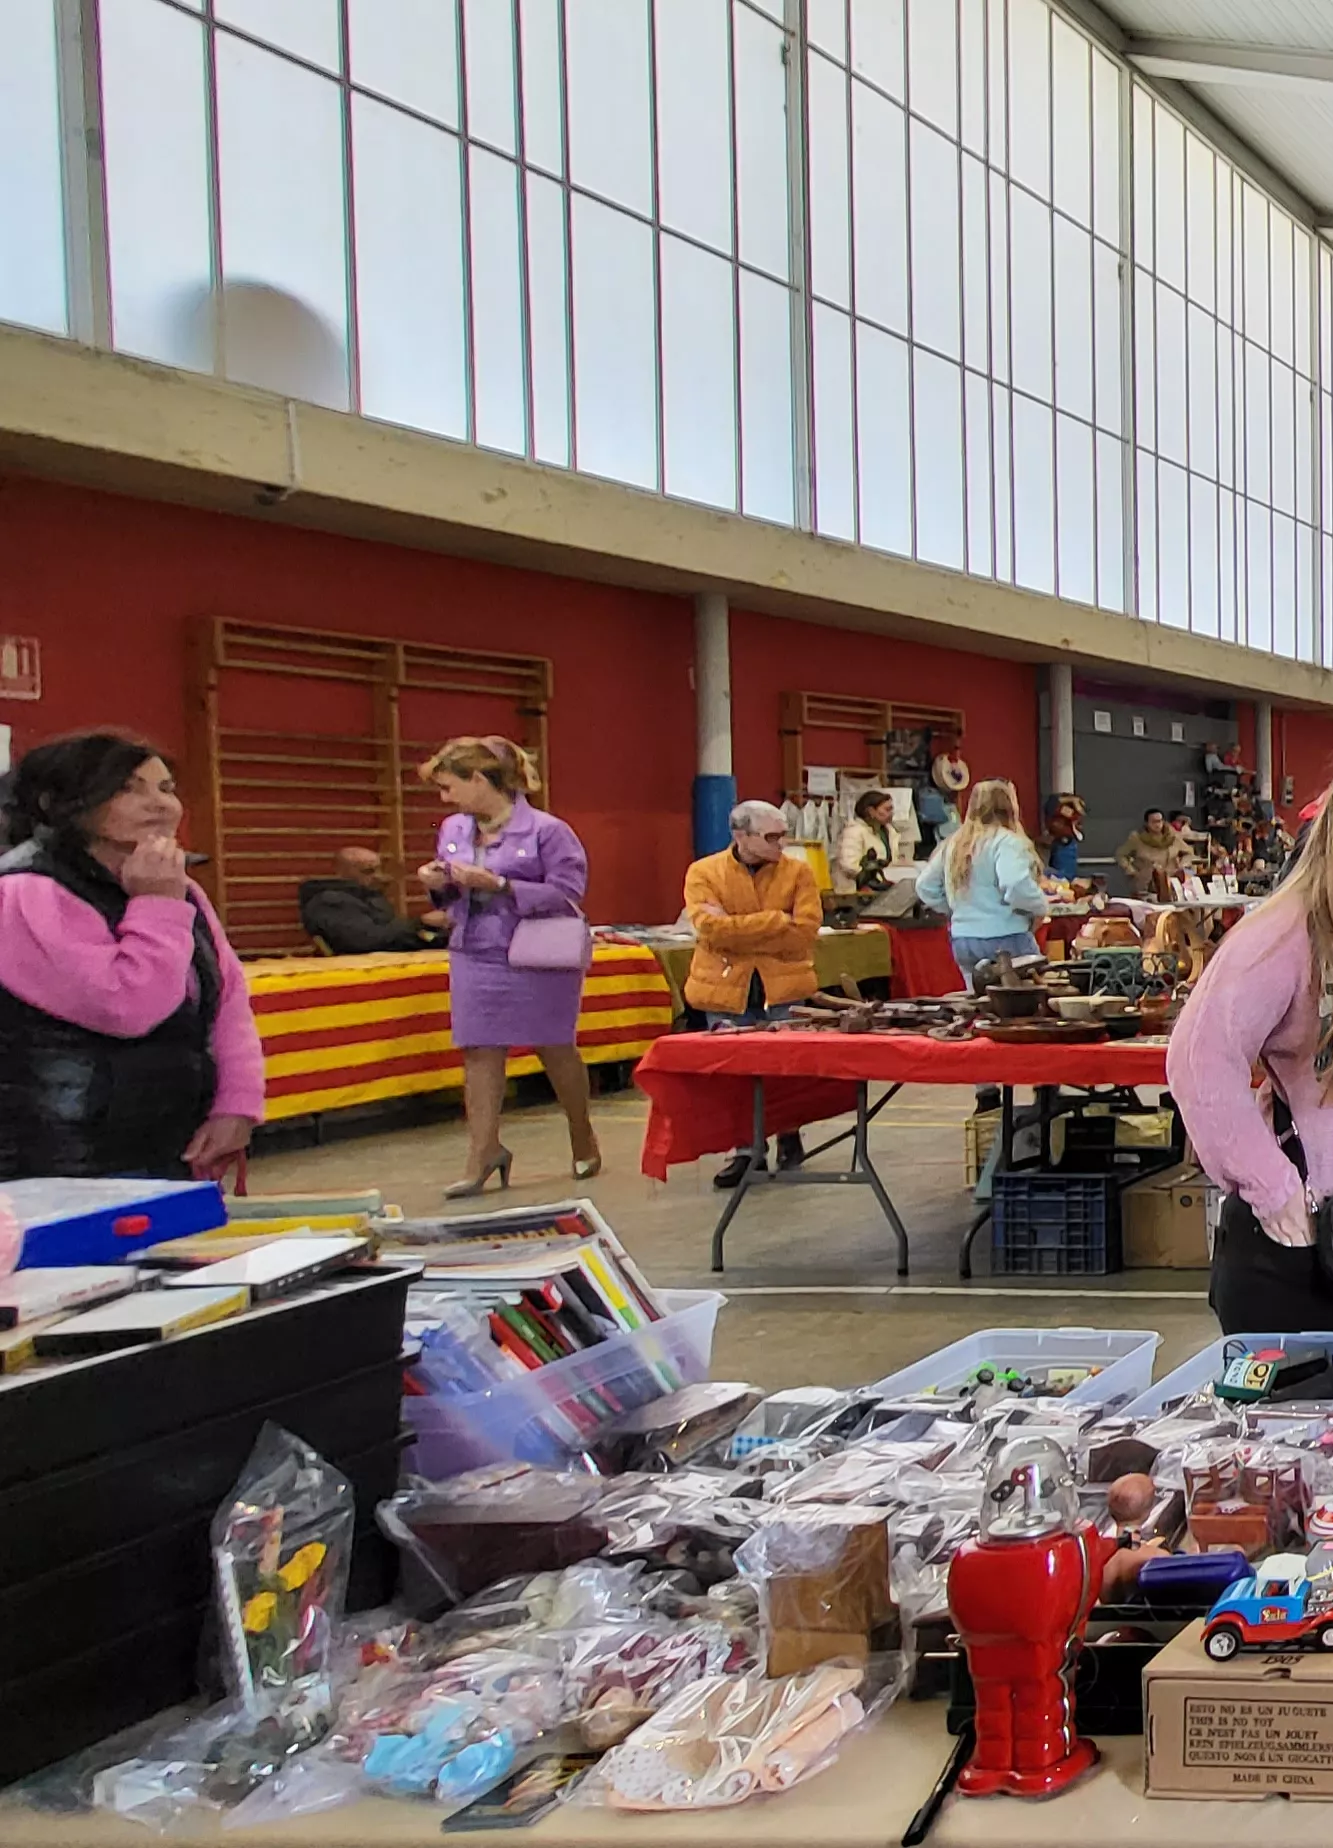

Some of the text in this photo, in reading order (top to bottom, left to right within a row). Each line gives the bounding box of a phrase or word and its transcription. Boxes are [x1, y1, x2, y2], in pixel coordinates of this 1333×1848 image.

[1189, 1704, 1215, 1714] ESTO
[1220, 1705, 1236, 1715] NO
[1241, 1705, 1252, 1715] ES
[1258, 1706, 1273, 1716] UN
[1189, 1716, 1275, 1728] THIS IS NO TOY
[1189, 1728, 1202, 1737] CE
[1241, 1729, 1260, 1739] PAS
[1265, 1730, 1280, 1740] UN
[1285, 1730, 1319, 1741] JOUET
[1188, 1751, 1230, 1762] QUESTO
[1234, 1753, 1256, 1763] NON
[1232, 1773, 1315, 1785] MADE IN CHINA
